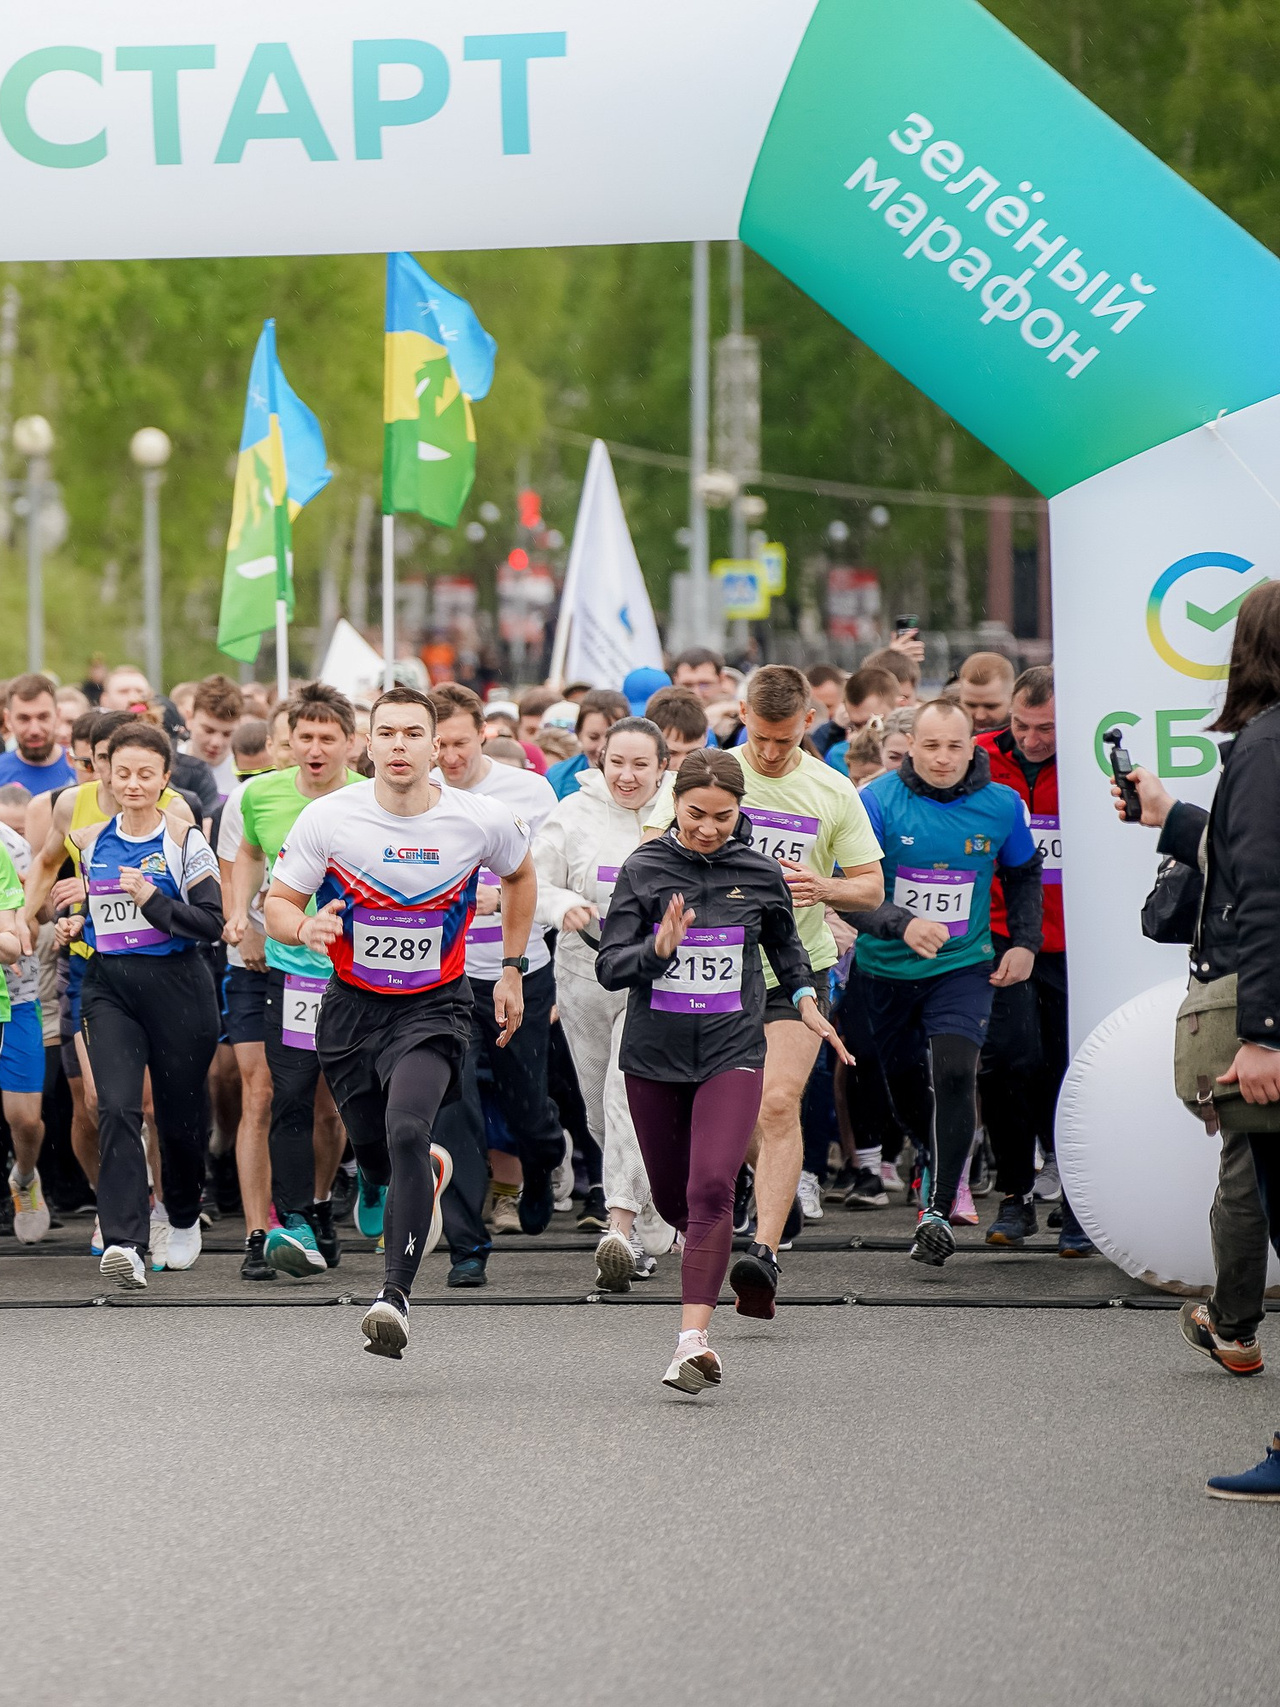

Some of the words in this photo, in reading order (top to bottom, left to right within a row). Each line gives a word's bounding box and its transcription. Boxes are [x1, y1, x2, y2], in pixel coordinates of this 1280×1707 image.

[887, 111, 1157, 334] зелёный
[843, 156, 1101, 379] марафон
[1094, 707, 1219, 780] СБ
[1037, 839, 1062, 858] 60
[100, 900, 138, 923] 207
[905, 889, 963, 912] 2151
[364, 935, 433, 961] 2289
[664, 956, 734, 981] 2152
[294, 1001, 320, 1023] 21
